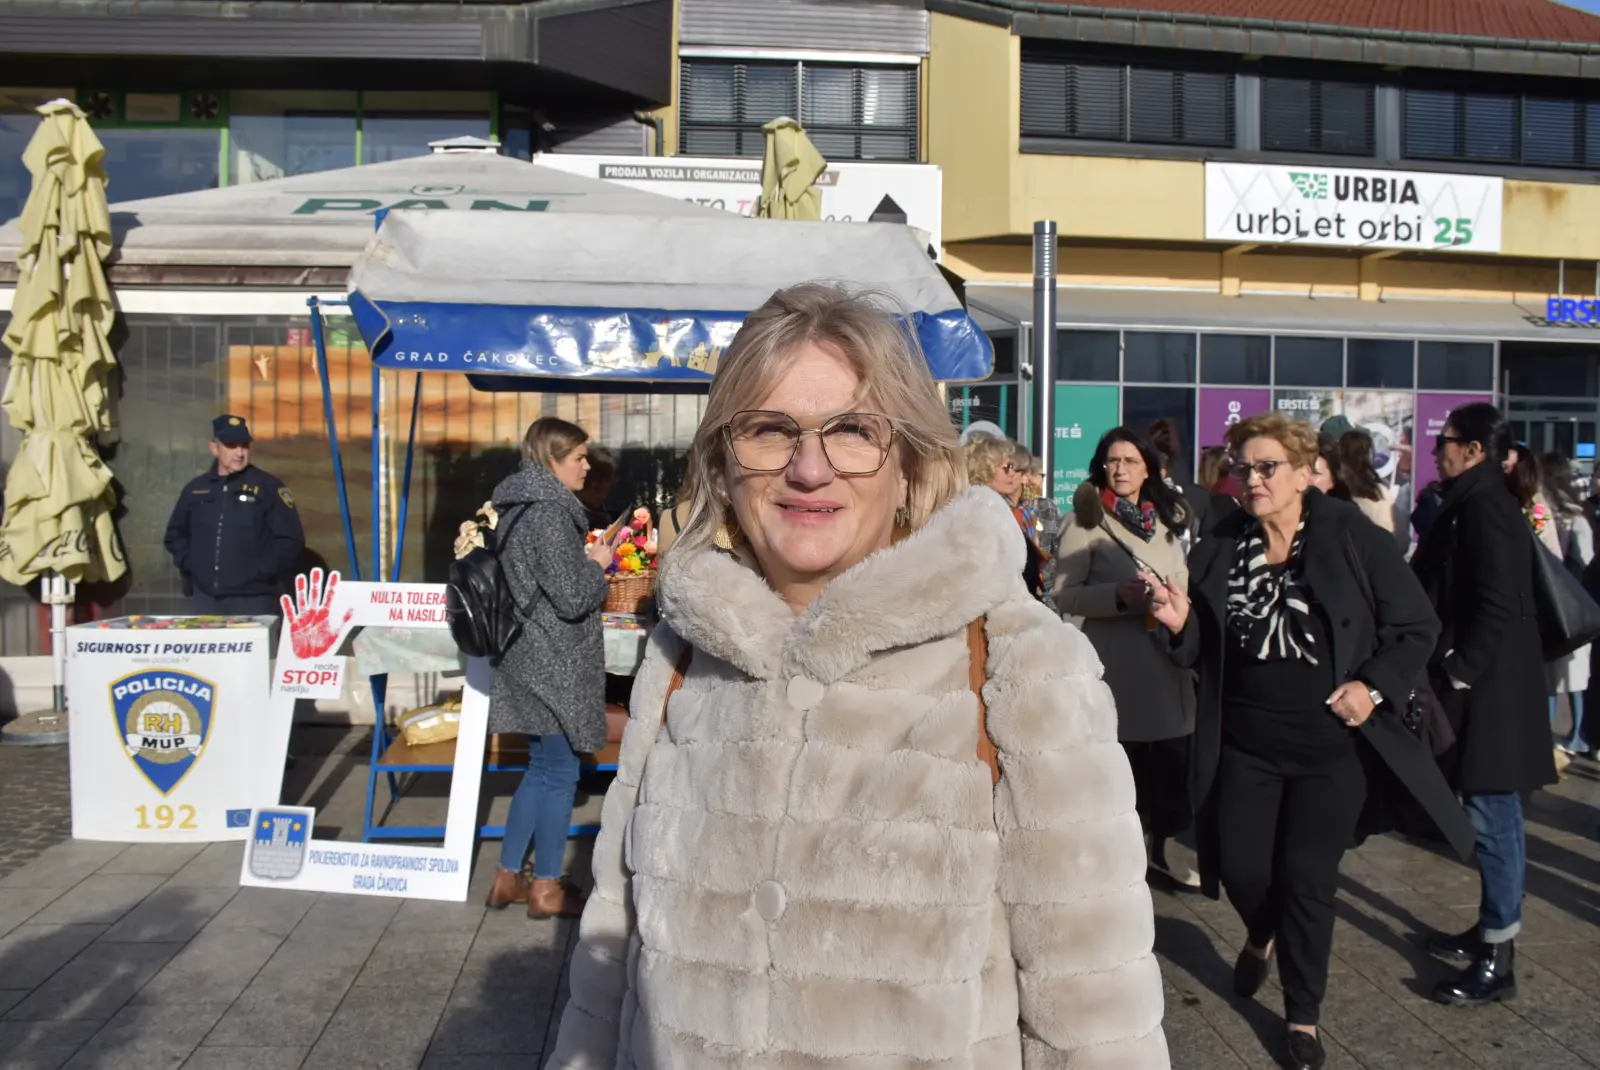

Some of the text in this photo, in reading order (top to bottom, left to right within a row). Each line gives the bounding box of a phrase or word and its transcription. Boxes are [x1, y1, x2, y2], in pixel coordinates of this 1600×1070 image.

[604, 166, 760, 182] PRODAJA VOZILA I ORGANIZACIJA
[1334, 175, 1420, 205] URBIA
[292, 198, 550, 215] PAN
[1236, 207, 1473, 244] urbi et orbi 25
[395, 351, 449, 363] GRAD
[1277, 398, 1309, 410] ERSTE
[370, 590, 448, 605] NULTA TOLERA
[388, 607, 403, 621] NA
[77, 642, 253, 654] SIGURNOST I POVJERENJE
[282, 669, 339, 686] STOP!
[113, 677, 212, 702] POLICIJA
[143, 712, 183, 734] RH
[141, 737, 186, 749] MUP
[135, 803, 198, 829] 192
[308, 850, 459, 873] POVJERENSTVO ZA RAVNOPRAVNOST SPOLOVA
[352, 873, 408, 891] GRADA ČAKOVCA
